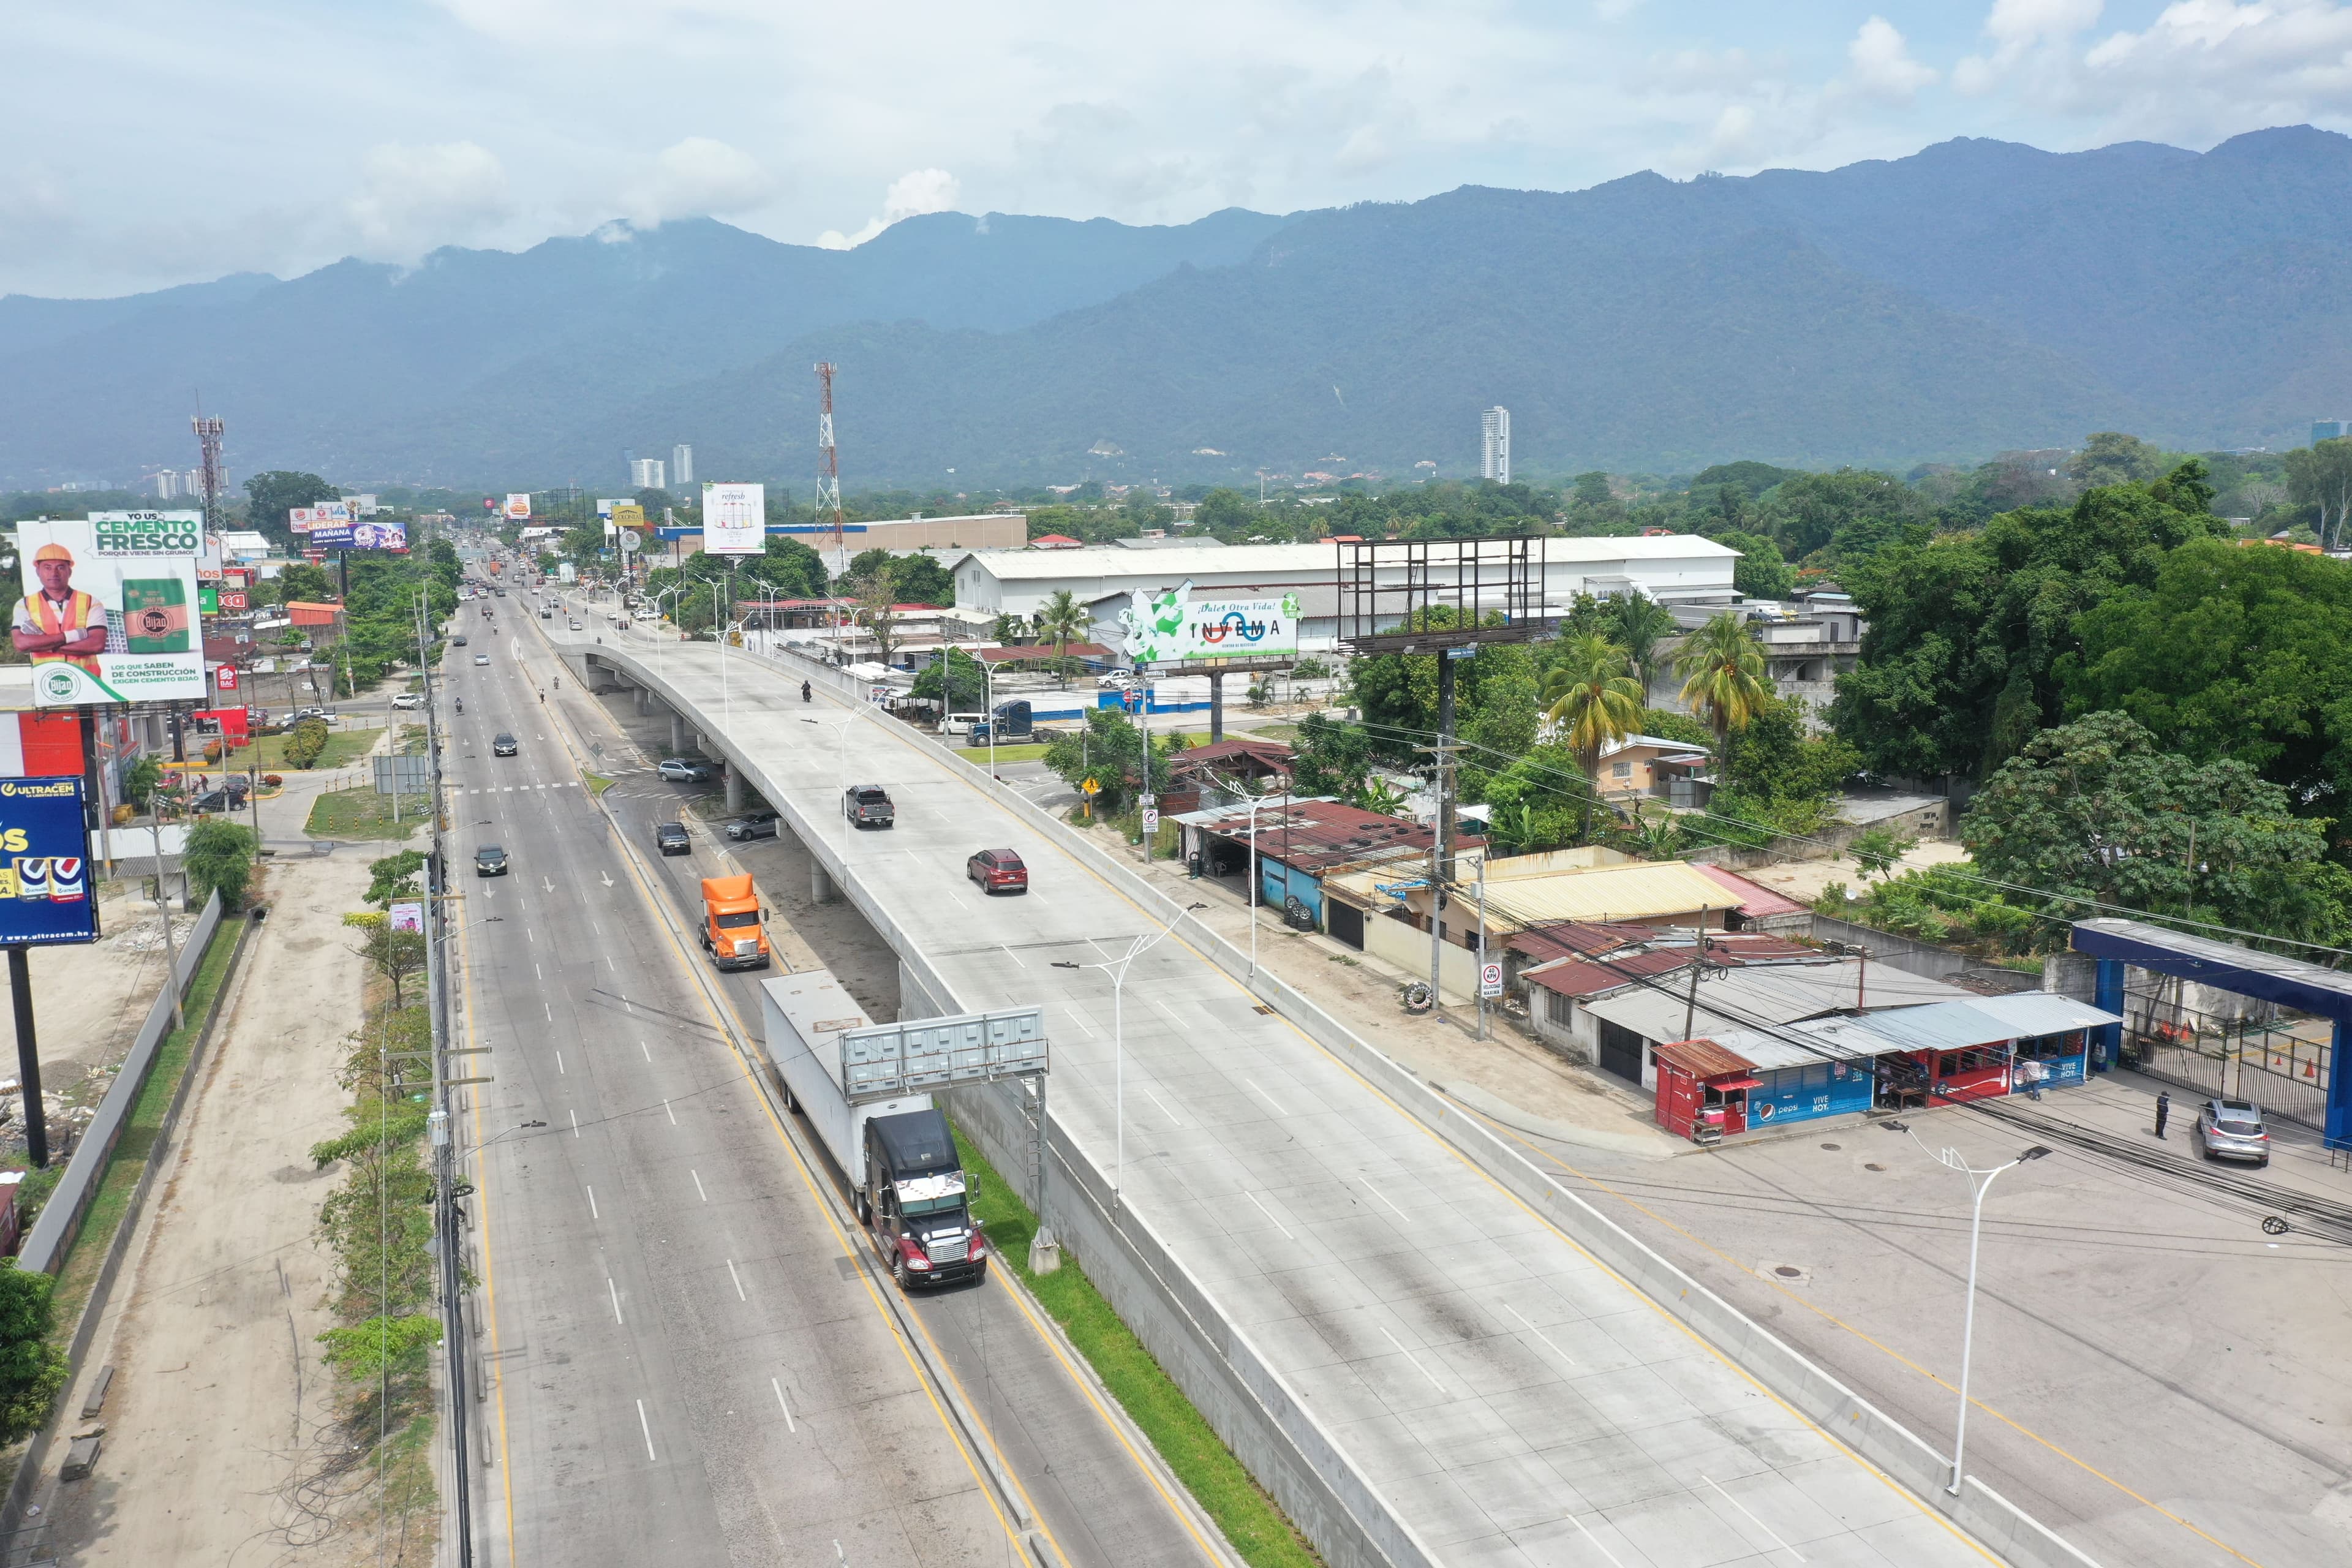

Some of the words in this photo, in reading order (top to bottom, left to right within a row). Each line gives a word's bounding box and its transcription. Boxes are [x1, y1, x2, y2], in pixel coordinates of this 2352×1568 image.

[96, 520, 197, 534] CEMENTO
[307, 521, 345, 530] LIDERAR
[314, 529, 350, 538] MAÑANA
[96, 533, 198, 550] FRESCO
[141, 606, 167, 615] CEMENTO
[1197, 603, 1226, 614] ¡Dales
[1252, 602, 1276, 611] Vida!
[145, 616, 167, 630] Bijao
[143, 628, 170, 638] PORTLAND
[1191, 620, 1280, 638] INVEMA
[126, 667, 196, 677] CONSTRUCCIÓN
[51, 680, 72, 693] Bijao
[17, 785, 75, 795] ULTRACEM
[2061, 1062, 2077, 1071] VIVE
[1813, 1095, 1828, 1104] VIVE
[1778, 1103, 1798, 1115] pepsi
[1812, 1104, 1829, 1113] HOY.
